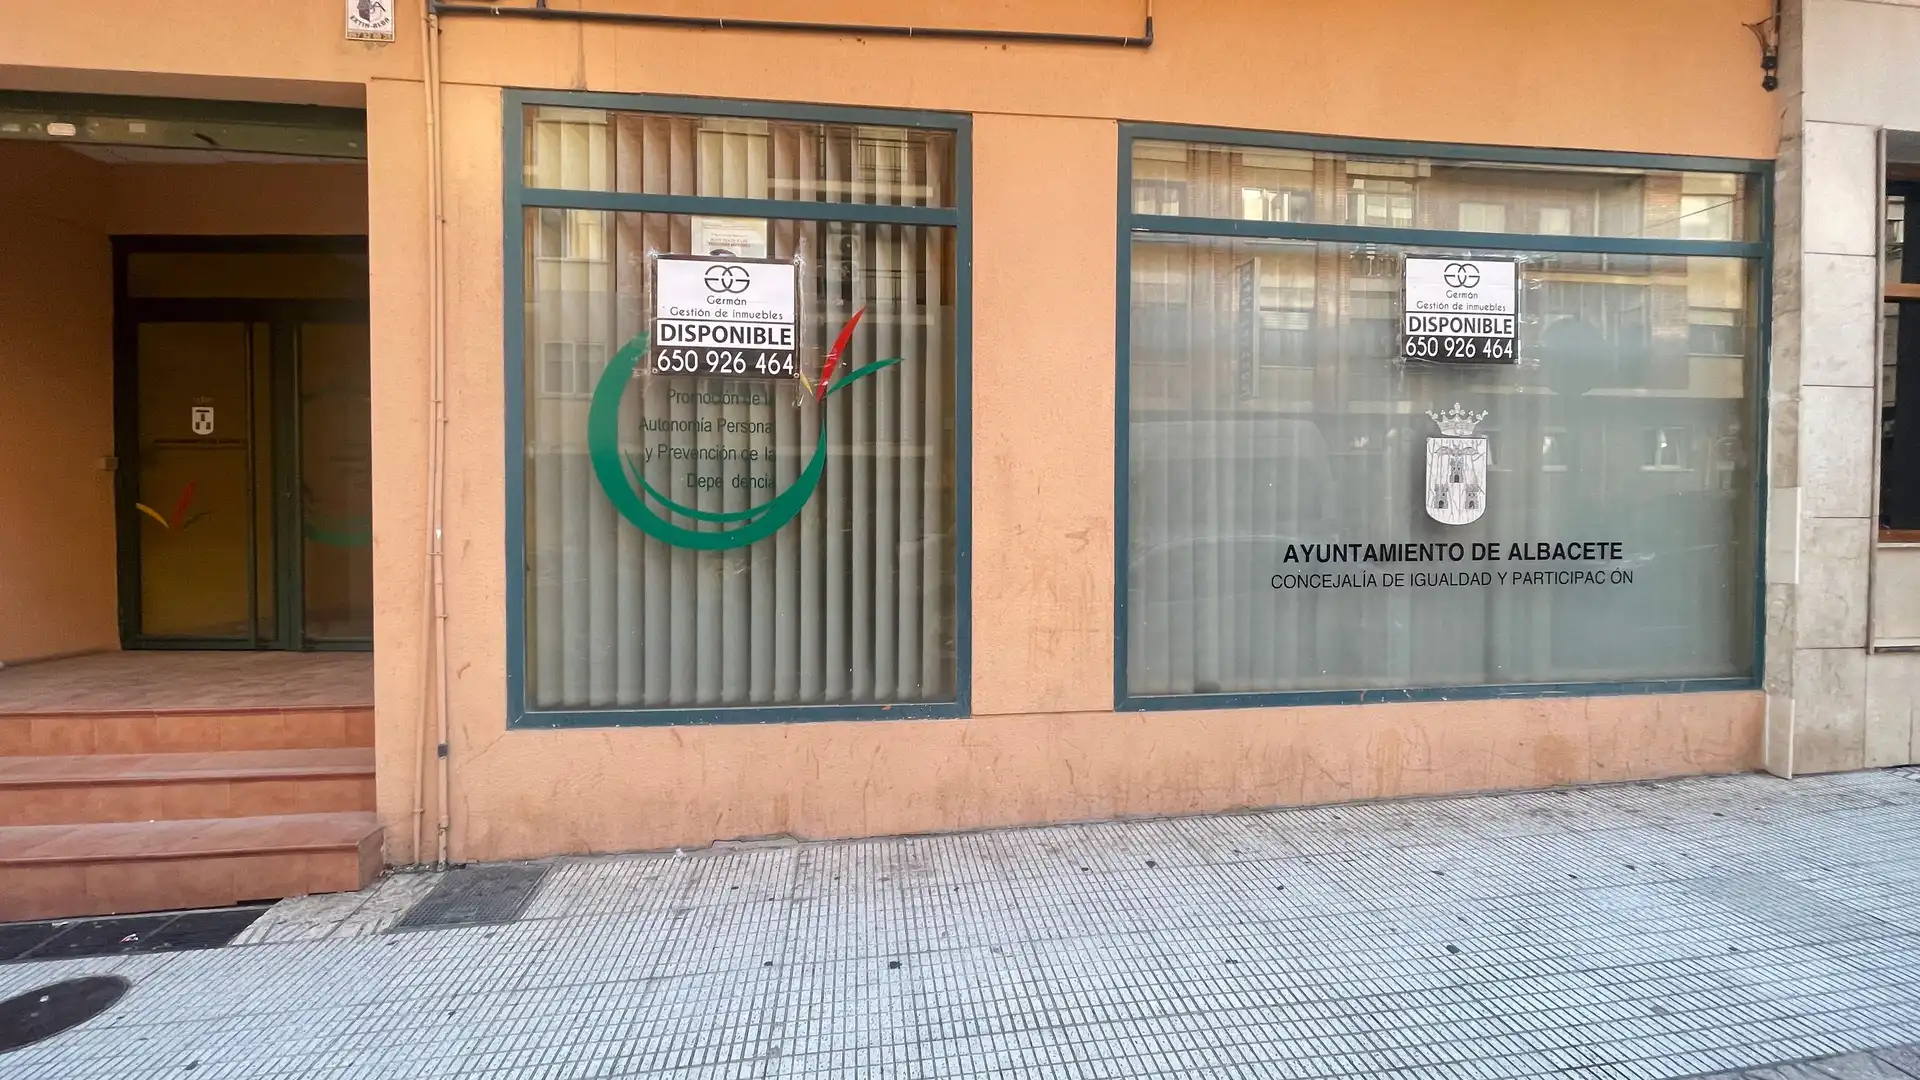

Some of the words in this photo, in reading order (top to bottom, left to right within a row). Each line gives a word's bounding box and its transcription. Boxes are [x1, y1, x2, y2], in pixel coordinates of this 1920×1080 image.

[707, 295, 747, 306] Germán
[1446, 289, 1478, 299] Germán
[670, 306, 711, 318] Gestión
[715, 308, 728, 318] de
[732, 310, 783, 320] inmuebles
[1416, 300, 1449, 310] Gestión
[1452, 301, 1463, 311] de
[1466, 302, 1506, 312] inmuebles
[1409, 316, 1512, 334] DISPONIBLE
[661, 323, 792, 346] DISPONIBLE
[1406, 336, 1438, 357] 650
[1444, 337, 1476, 358] 926
[1483, 338, 1513, 359] 464
[657, 349, 698, 372] 650
[706, 351, 746, 374] 926
[755, 352, 793, 375] 464
[668, 389, 739, 405] Promocón
[639, 417, 712, 432] Autonomía
[645, 447, 653, 462] y
[658, 444, 737, 461] Prevención
[765, 446, 776, 461] la
[687, 473, 775, 490] Depedencia
[1284, 543, 1465, 563] AYUNTAMIENTO
[1472, 542, 1501, 561] DE
[1508, 542, 1623, 561] ALBACETE
[1271, 570, 1377, 589] CONCEJALÍA
[1383, 573, 1405, 587] DE
[1410, 572, 1492, 587] IGUALDAD
[1497, 572, 1507, 586] Y
[1512, 567, 1633, 586] PARTICIPACÓN
